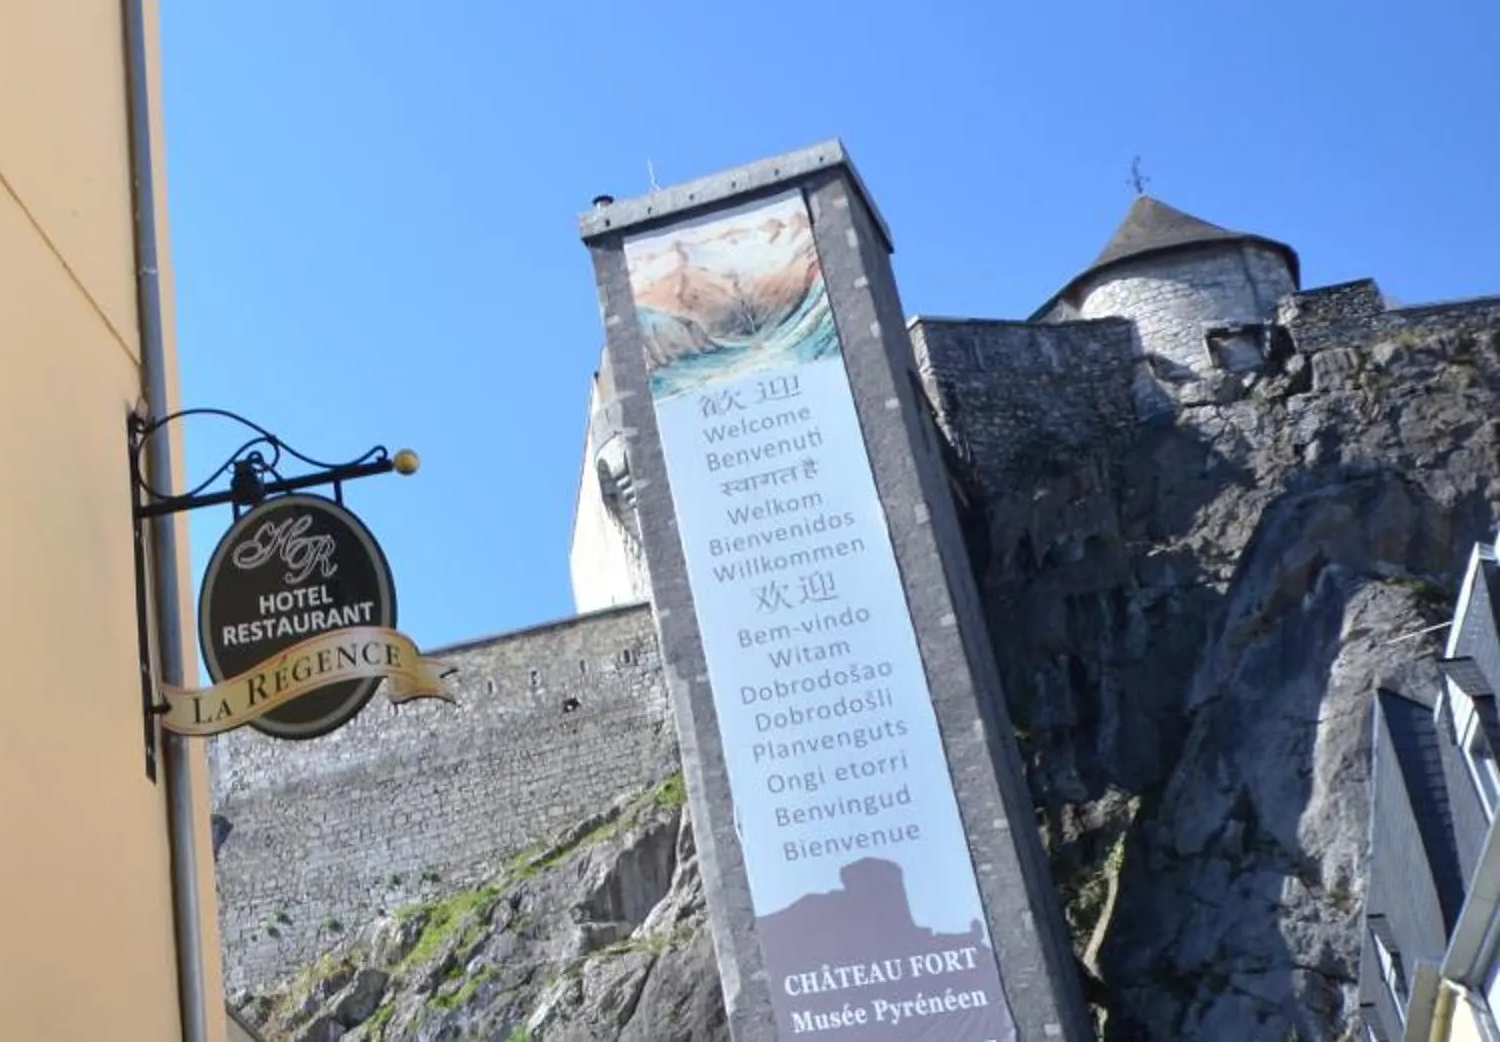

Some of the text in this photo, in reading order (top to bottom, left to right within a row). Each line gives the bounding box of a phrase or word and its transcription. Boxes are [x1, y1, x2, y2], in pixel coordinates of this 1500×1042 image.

[703, 407, 812, 444] Welcome
[706, 426, 823, 472] Benvenuti
[727, 492, 823, 525] Welkom
[709, 511, 855, 557] Bienvenidos
[713, 538, 865, 583] Willkommen
[259, 585, 333, 615] HOTEL
[752, 571, 839, 614] 欢迎
[223, 601, 374, 646] RESTAURANT
[737, 605, 870, 648] Bem-vindo
[768, 640, 851, 669] Witam
[740, 661, 893, 705] Dobrodošao
[192, 696, 232, 724] LA
[755, 687, 893, 732] Dobrodošli
[752, 719, 908, 764] Planvenguts
[767, 749, 908, 793] Ongi etorri
[775, 782, 912, 827] Benvingud
[783, 823, 921, 861] Bienvenue
[784, 947, 978, 996] CHÂTEAU FORT
[791, 987, 989, 1034] Musée Pyrénéen
